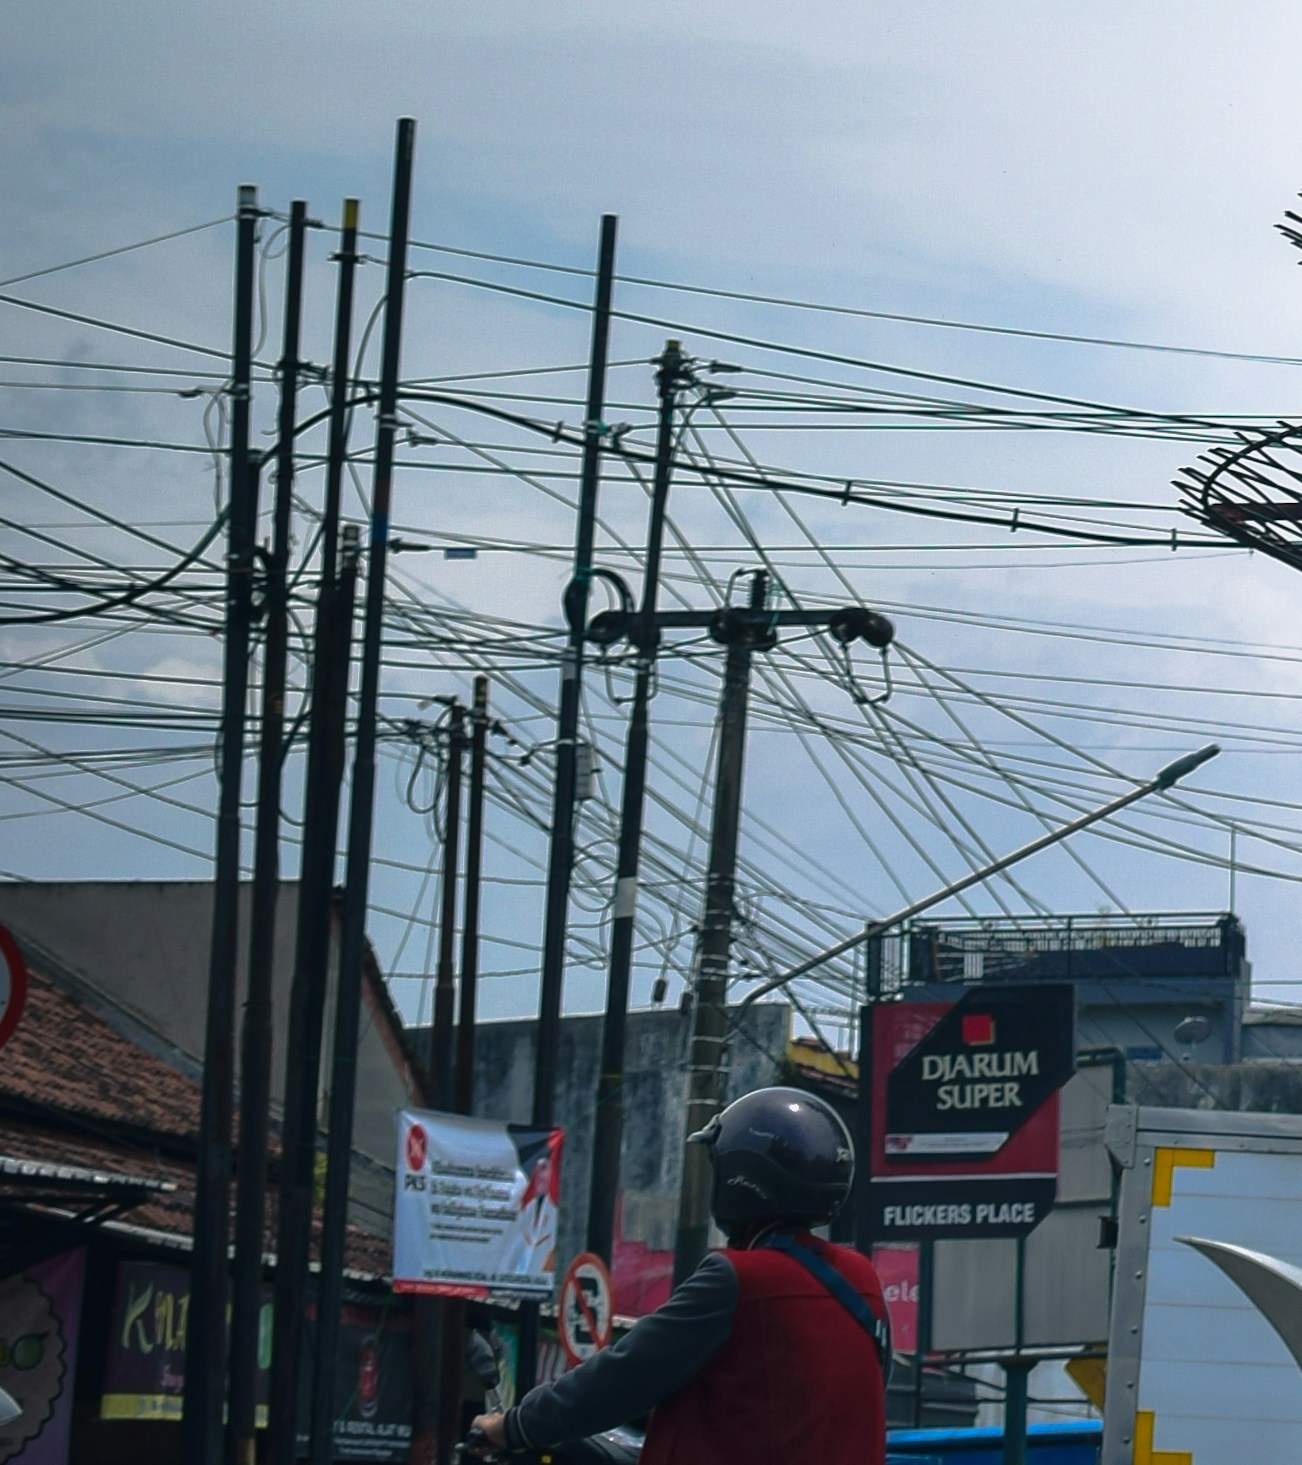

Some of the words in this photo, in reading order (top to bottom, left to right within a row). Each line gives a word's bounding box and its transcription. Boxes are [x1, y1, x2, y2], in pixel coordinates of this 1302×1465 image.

[921, 1049, 1040, 1082] DJARUM
[936, 1082, 1023, 1110] SUPER
[883, 1202, 972, 1226] FLICKERS
[976, 1202, 1036, 1224] PLACE
